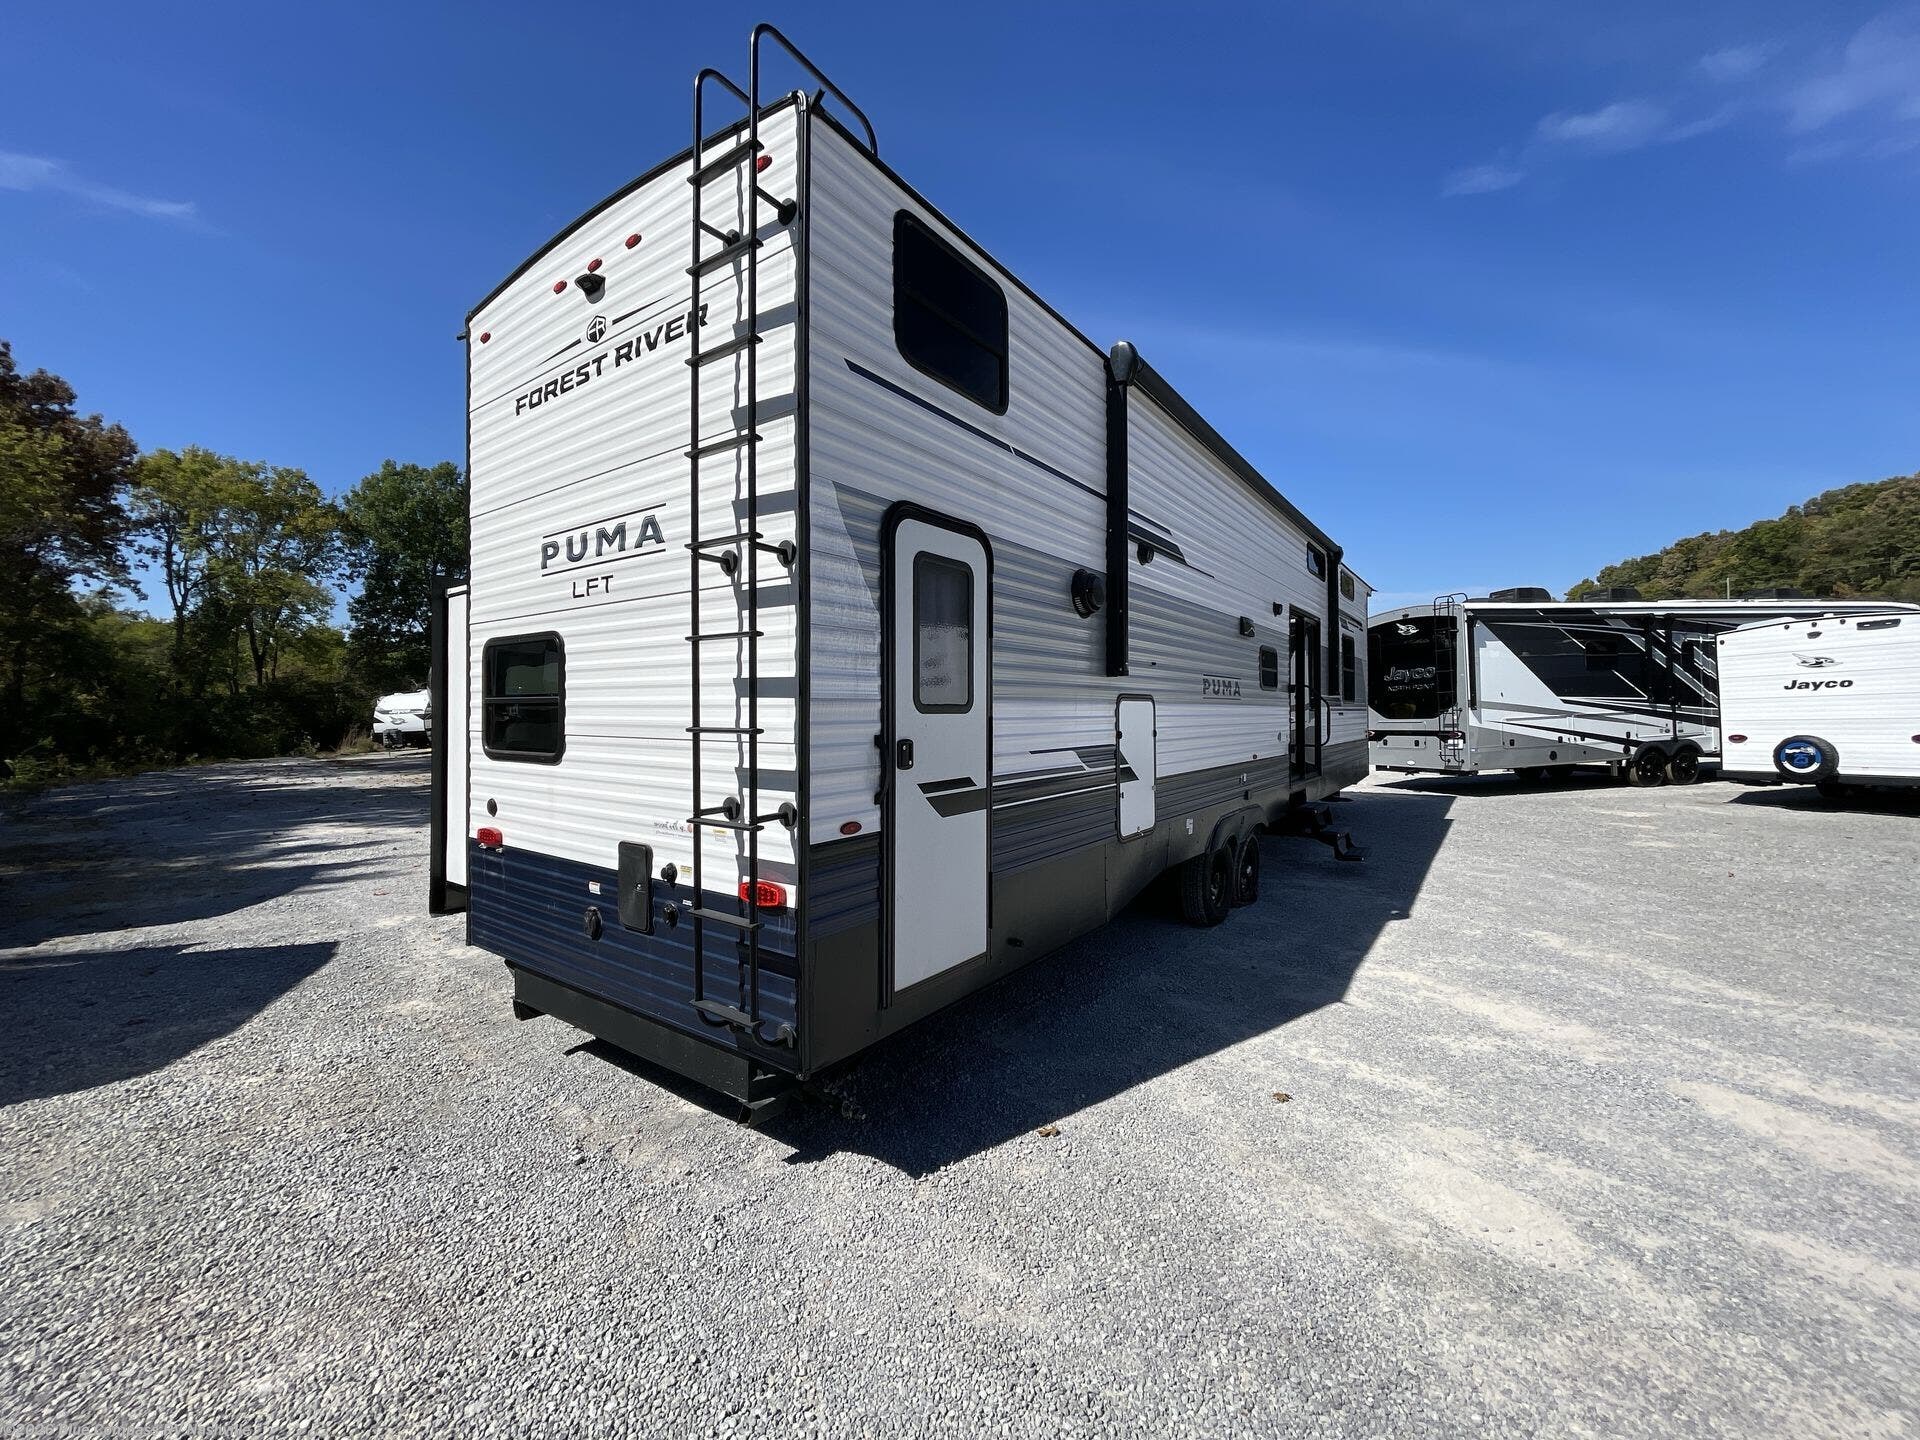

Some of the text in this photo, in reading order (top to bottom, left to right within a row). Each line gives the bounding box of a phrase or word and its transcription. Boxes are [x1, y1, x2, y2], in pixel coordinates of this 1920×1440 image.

[515, 303, 709, 416] FOREST RIVER
[540, 514, 666, 570] PUMA
[572, 574, 614, 599] LFT
[1383, 666, 1436, 682] Jayco
[1202, 678, 1241, 696] PUMA
[1783, 679, 1853, 691] Jayco
